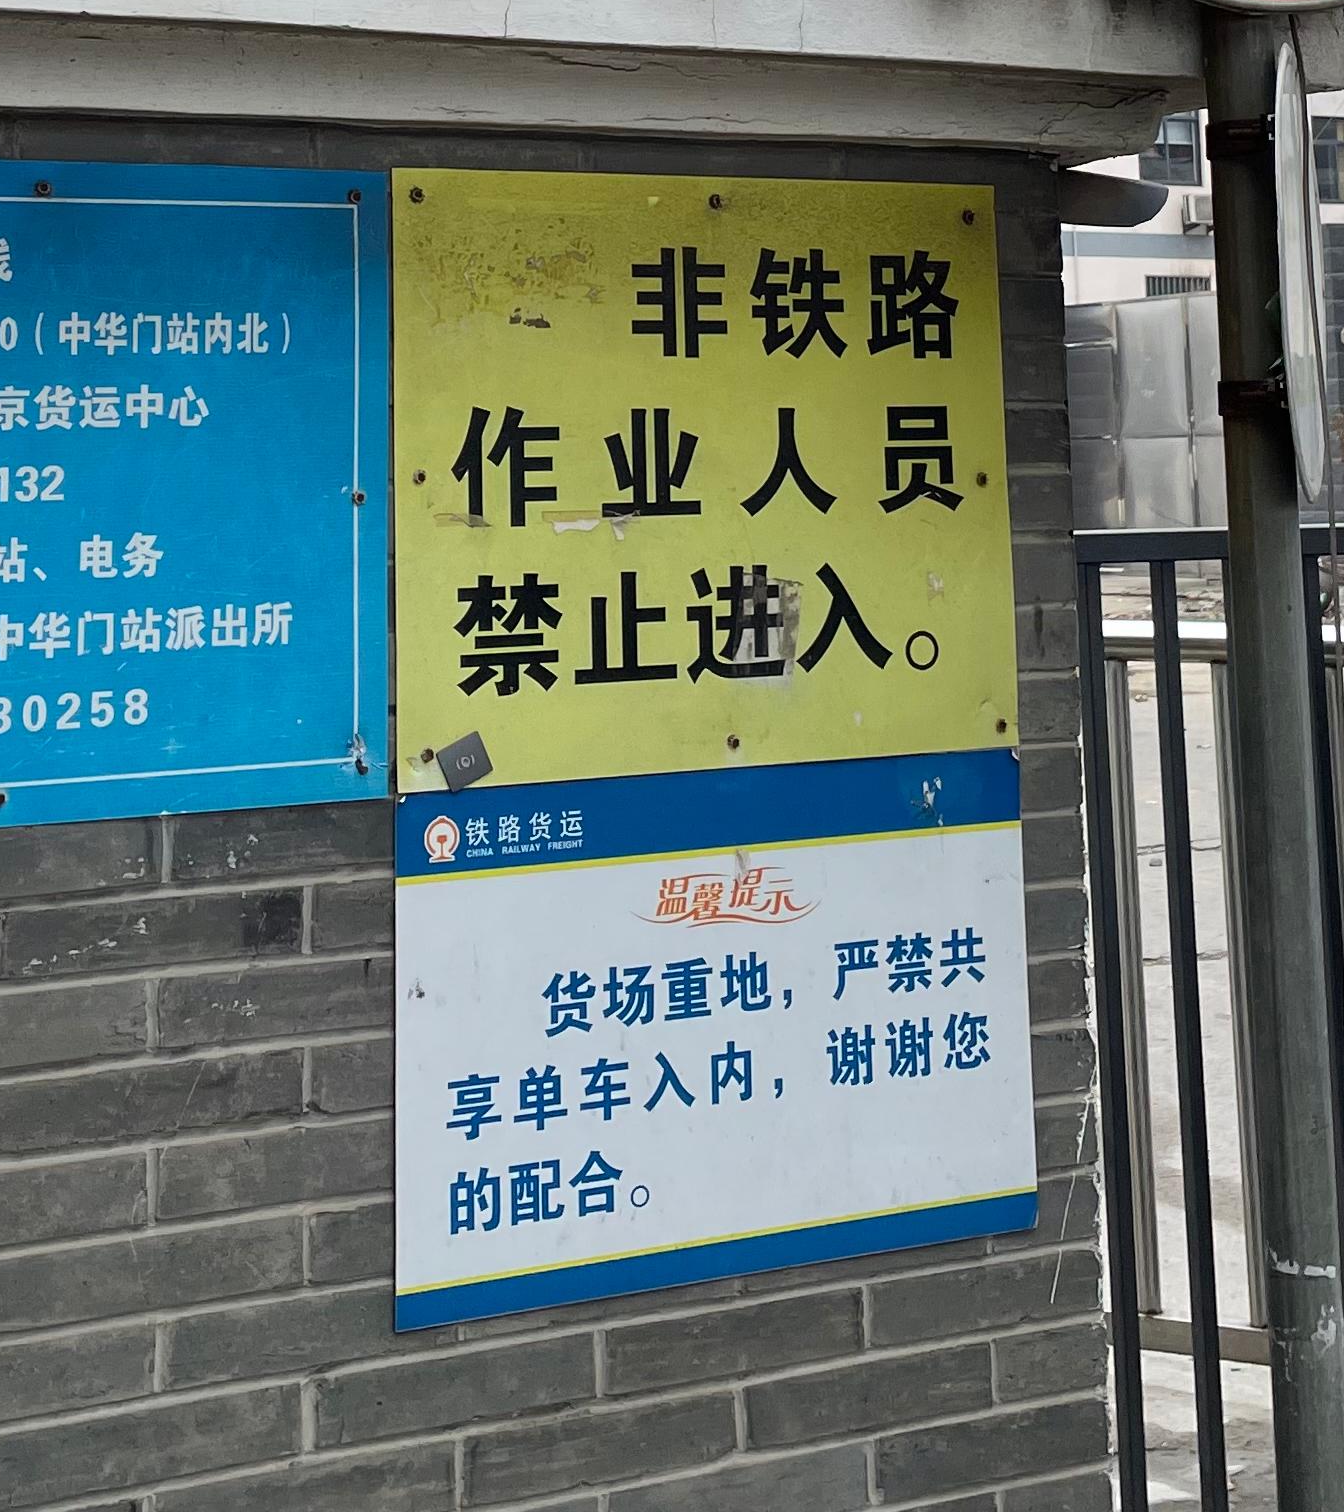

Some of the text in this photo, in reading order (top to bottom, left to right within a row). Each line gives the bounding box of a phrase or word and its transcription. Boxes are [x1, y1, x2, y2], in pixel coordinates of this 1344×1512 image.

[630, 245, 960, 360] 非铁路
[450, 404, 965, 528] 作业人员
[453, 562, 940, 698] 禁止进入。
[465, 809, 584, 846] 铁路货运
[466, 839, 584, 858] CHINA RAILWAY FREIGHT
[656, 866, 813, 921] 温馨提示
[448, 1150, 651, 1235] 的配合。
